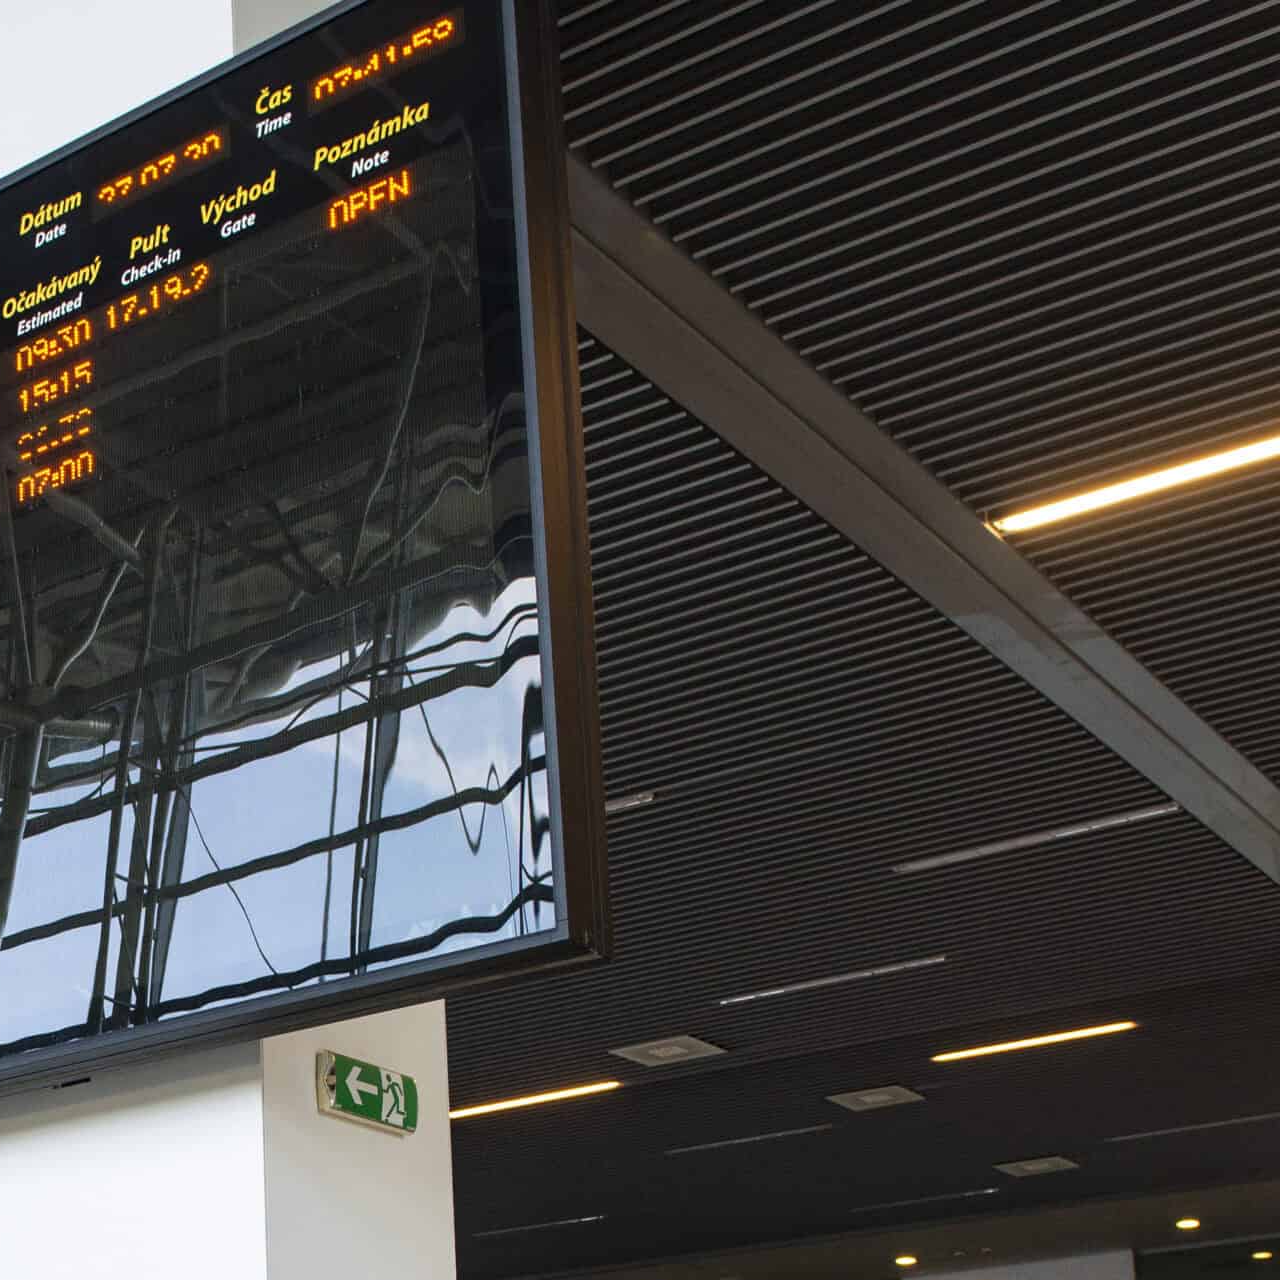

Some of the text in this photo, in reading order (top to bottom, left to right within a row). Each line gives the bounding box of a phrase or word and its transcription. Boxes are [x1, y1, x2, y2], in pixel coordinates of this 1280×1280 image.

[255, 85, 293, 115] Čas
[256, 112, 292, 138] Time
[313, 102, 430, 171] Poznámka
[351, 150, 389, 178] Note
[20, 191, 82, 235] Dátum
[200, 169, 277, 225] Východ
[35, 223, 67, 248] Date
[129, 224, 170, 260] Pult
[220, 213, 256, 238] Gate
[121, 248, 181, 286] Check-in
[2, 254, 102, 319] Očakávaný
[16, 292, 82, 337] Estimated
